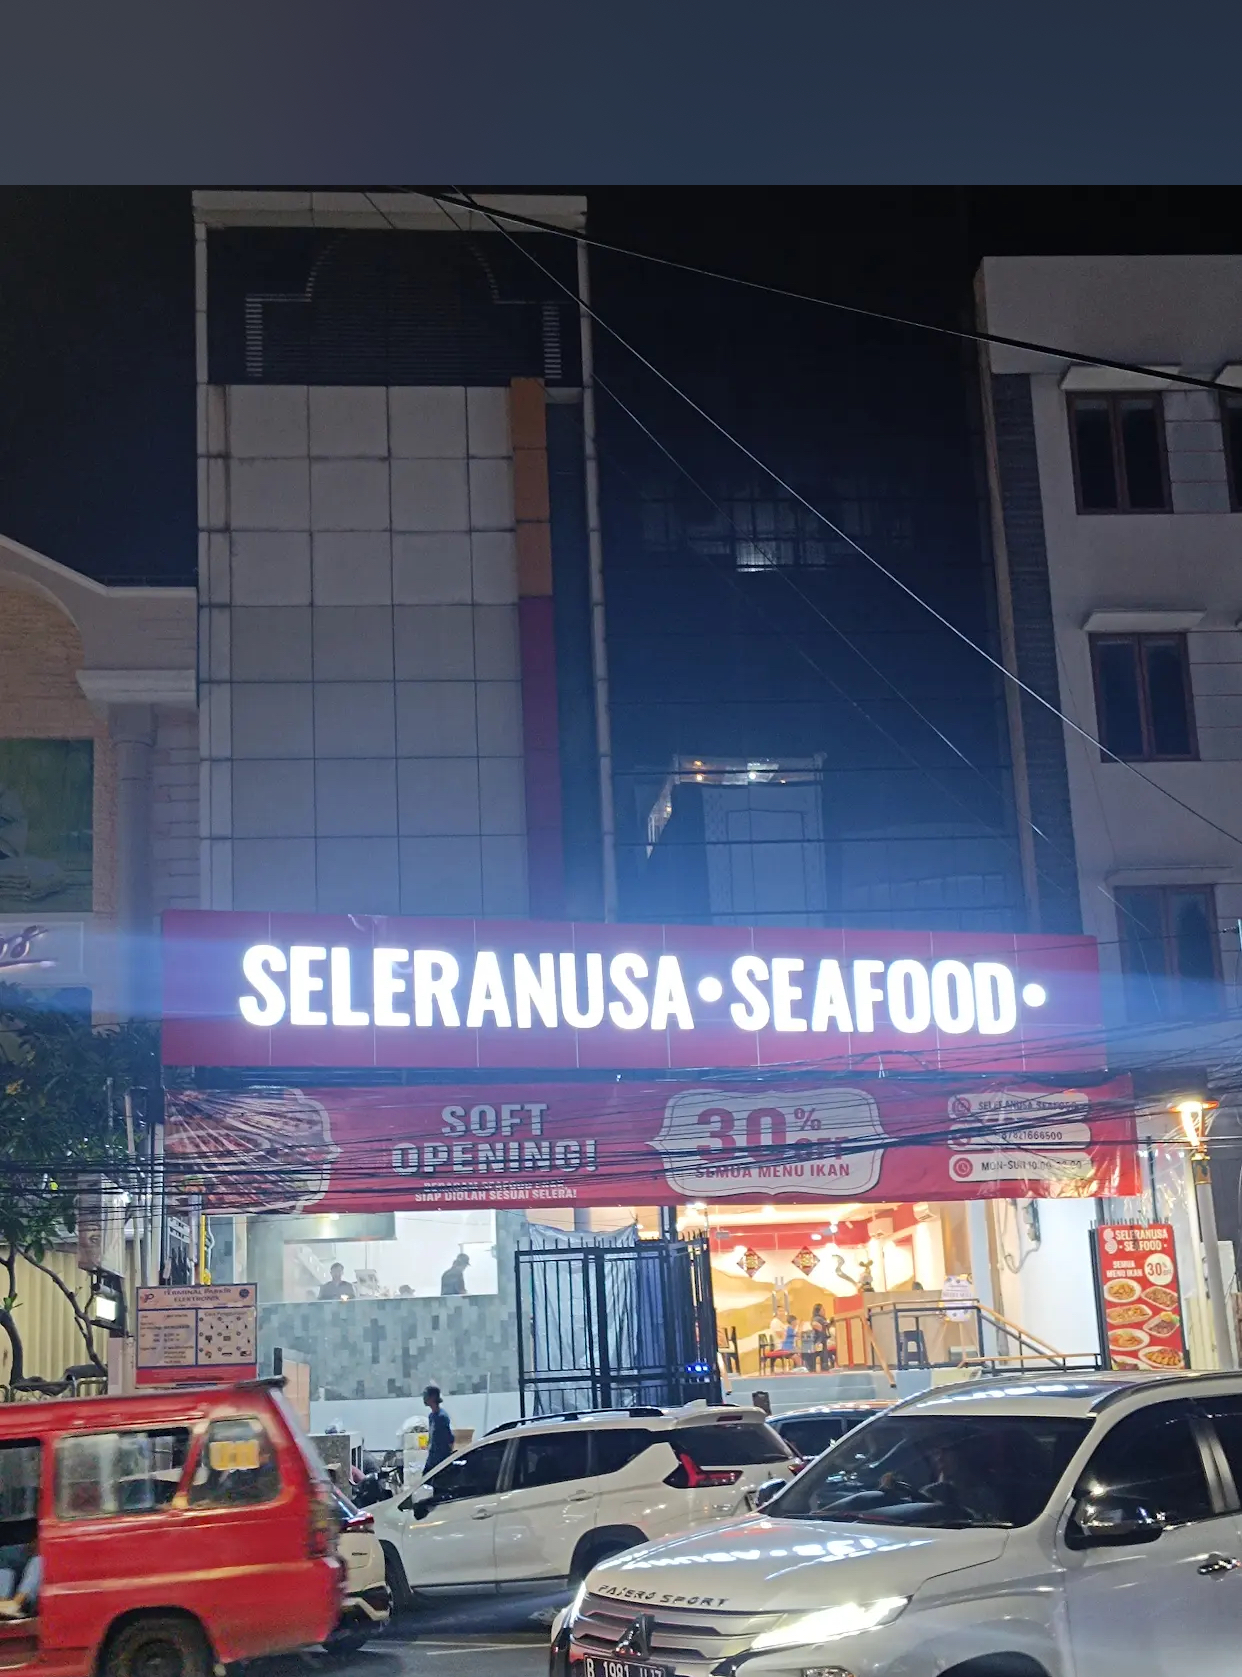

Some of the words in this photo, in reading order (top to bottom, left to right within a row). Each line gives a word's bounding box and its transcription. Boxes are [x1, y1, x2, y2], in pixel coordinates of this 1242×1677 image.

[239, 943, 694, 1031] SELERANUSA
[730, 955, 1017, 1035] SEAFOOD
[441, 1103, 548, 1138] SOFT
[391, 1139, 598, 1176] OPENING!
[695, 1165, 752, 1178] SEMUA
[758, 1165, 804, 1178] MENU
[811, 1163, 850, 1177] IKAN
[415, 1193, 442, 1202] SIAP
[489, 1190, 529, 1200] SESUAI
[532, 1188, 577, 1199] SELERA!
[1115, 1229, 1168, 1240] SELERANUSA
[598, 1585, 656, 1600] PAJERO
[660, 1594, 730, 1607] SPORT
